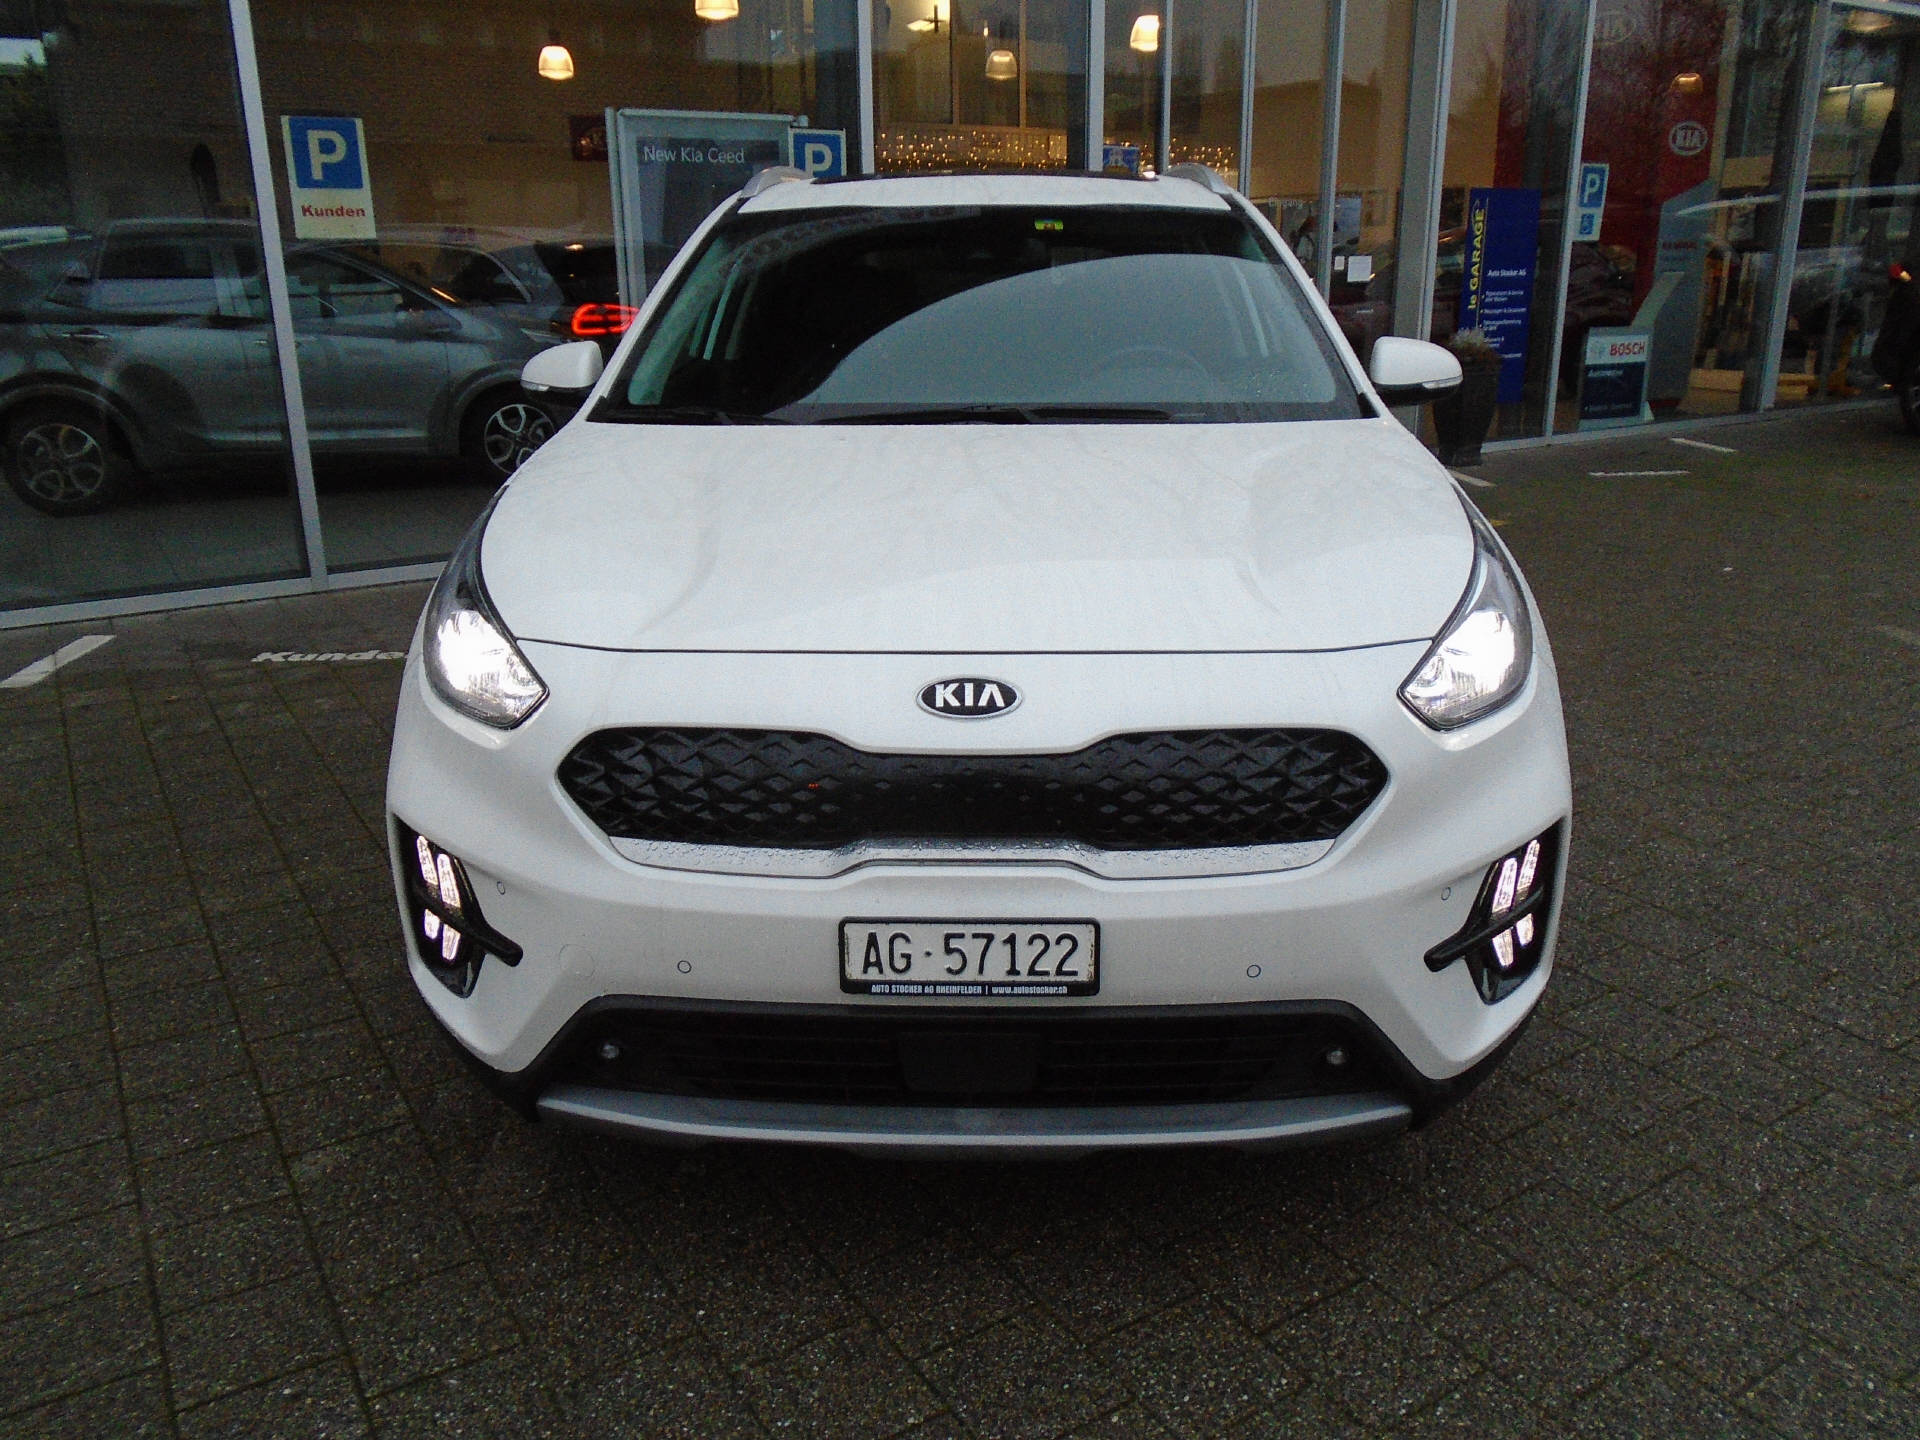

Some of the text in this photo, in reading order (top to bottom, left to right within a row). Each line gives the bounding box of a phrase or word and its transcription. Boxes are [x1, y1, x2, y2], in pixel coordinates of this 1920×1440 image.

[306, 130, 347, 180] P
[643, 146, 745, 163] New Kia Ceed
[804, 142, 833, 176] P
[1583, 173, 1600, 203] P
[301, 205, 366, 217] Kunden
[1467, 208, 1485, 310] le GARAGE
[1609, 342, 1646, 356] BOSCH
[251, 650, 408, 662] Kunde
[934, 682, 1006, 708] KIA
[862, 931, 912, 975] AG
[943, 932, 1079, 977] 57122
[871, 984, 890, 993] AUTO
